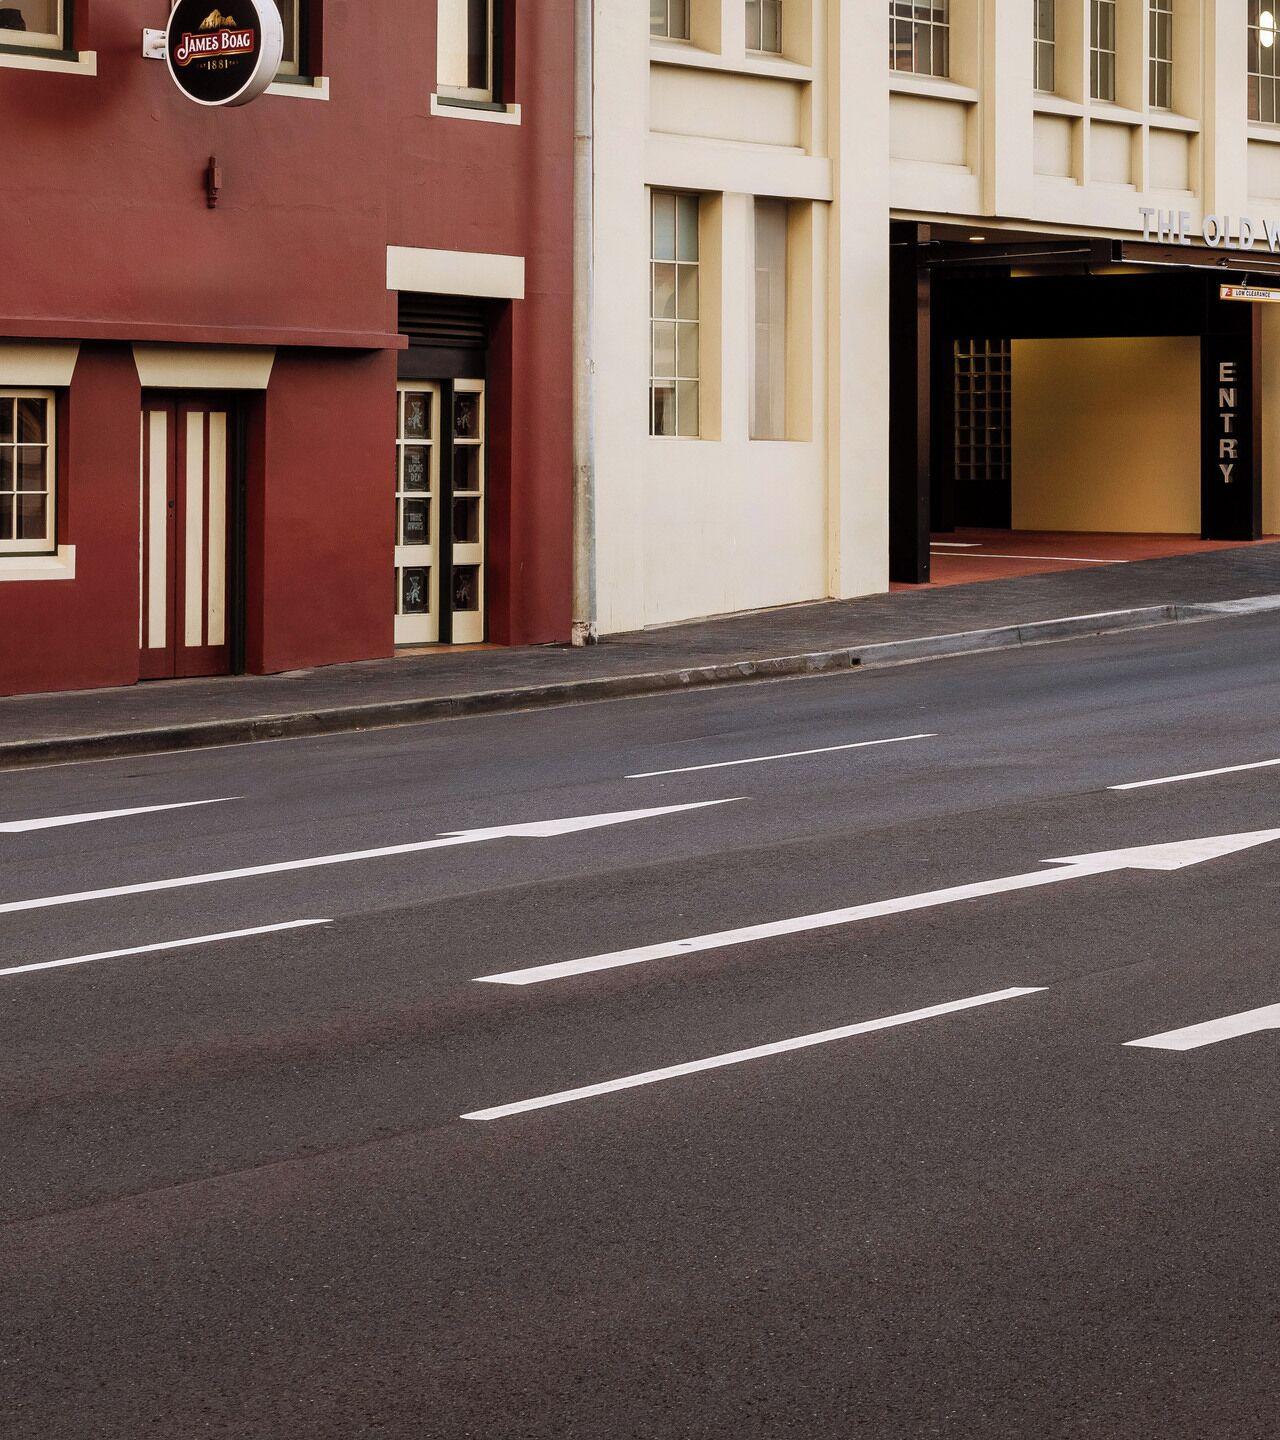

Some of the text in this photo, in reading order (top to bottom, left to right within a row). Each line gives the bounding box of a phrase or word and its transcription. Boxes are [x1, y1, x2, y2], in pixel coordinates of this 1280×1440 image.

[207, 59, 228, 70] 1881
[1138, 207, 1192, 245] THE
[1202, 215, 1256, 250] OLD
[1245, 290, 1271, 298] CLEARANCE
[1219, 362, 1238, 483] ENTRY
